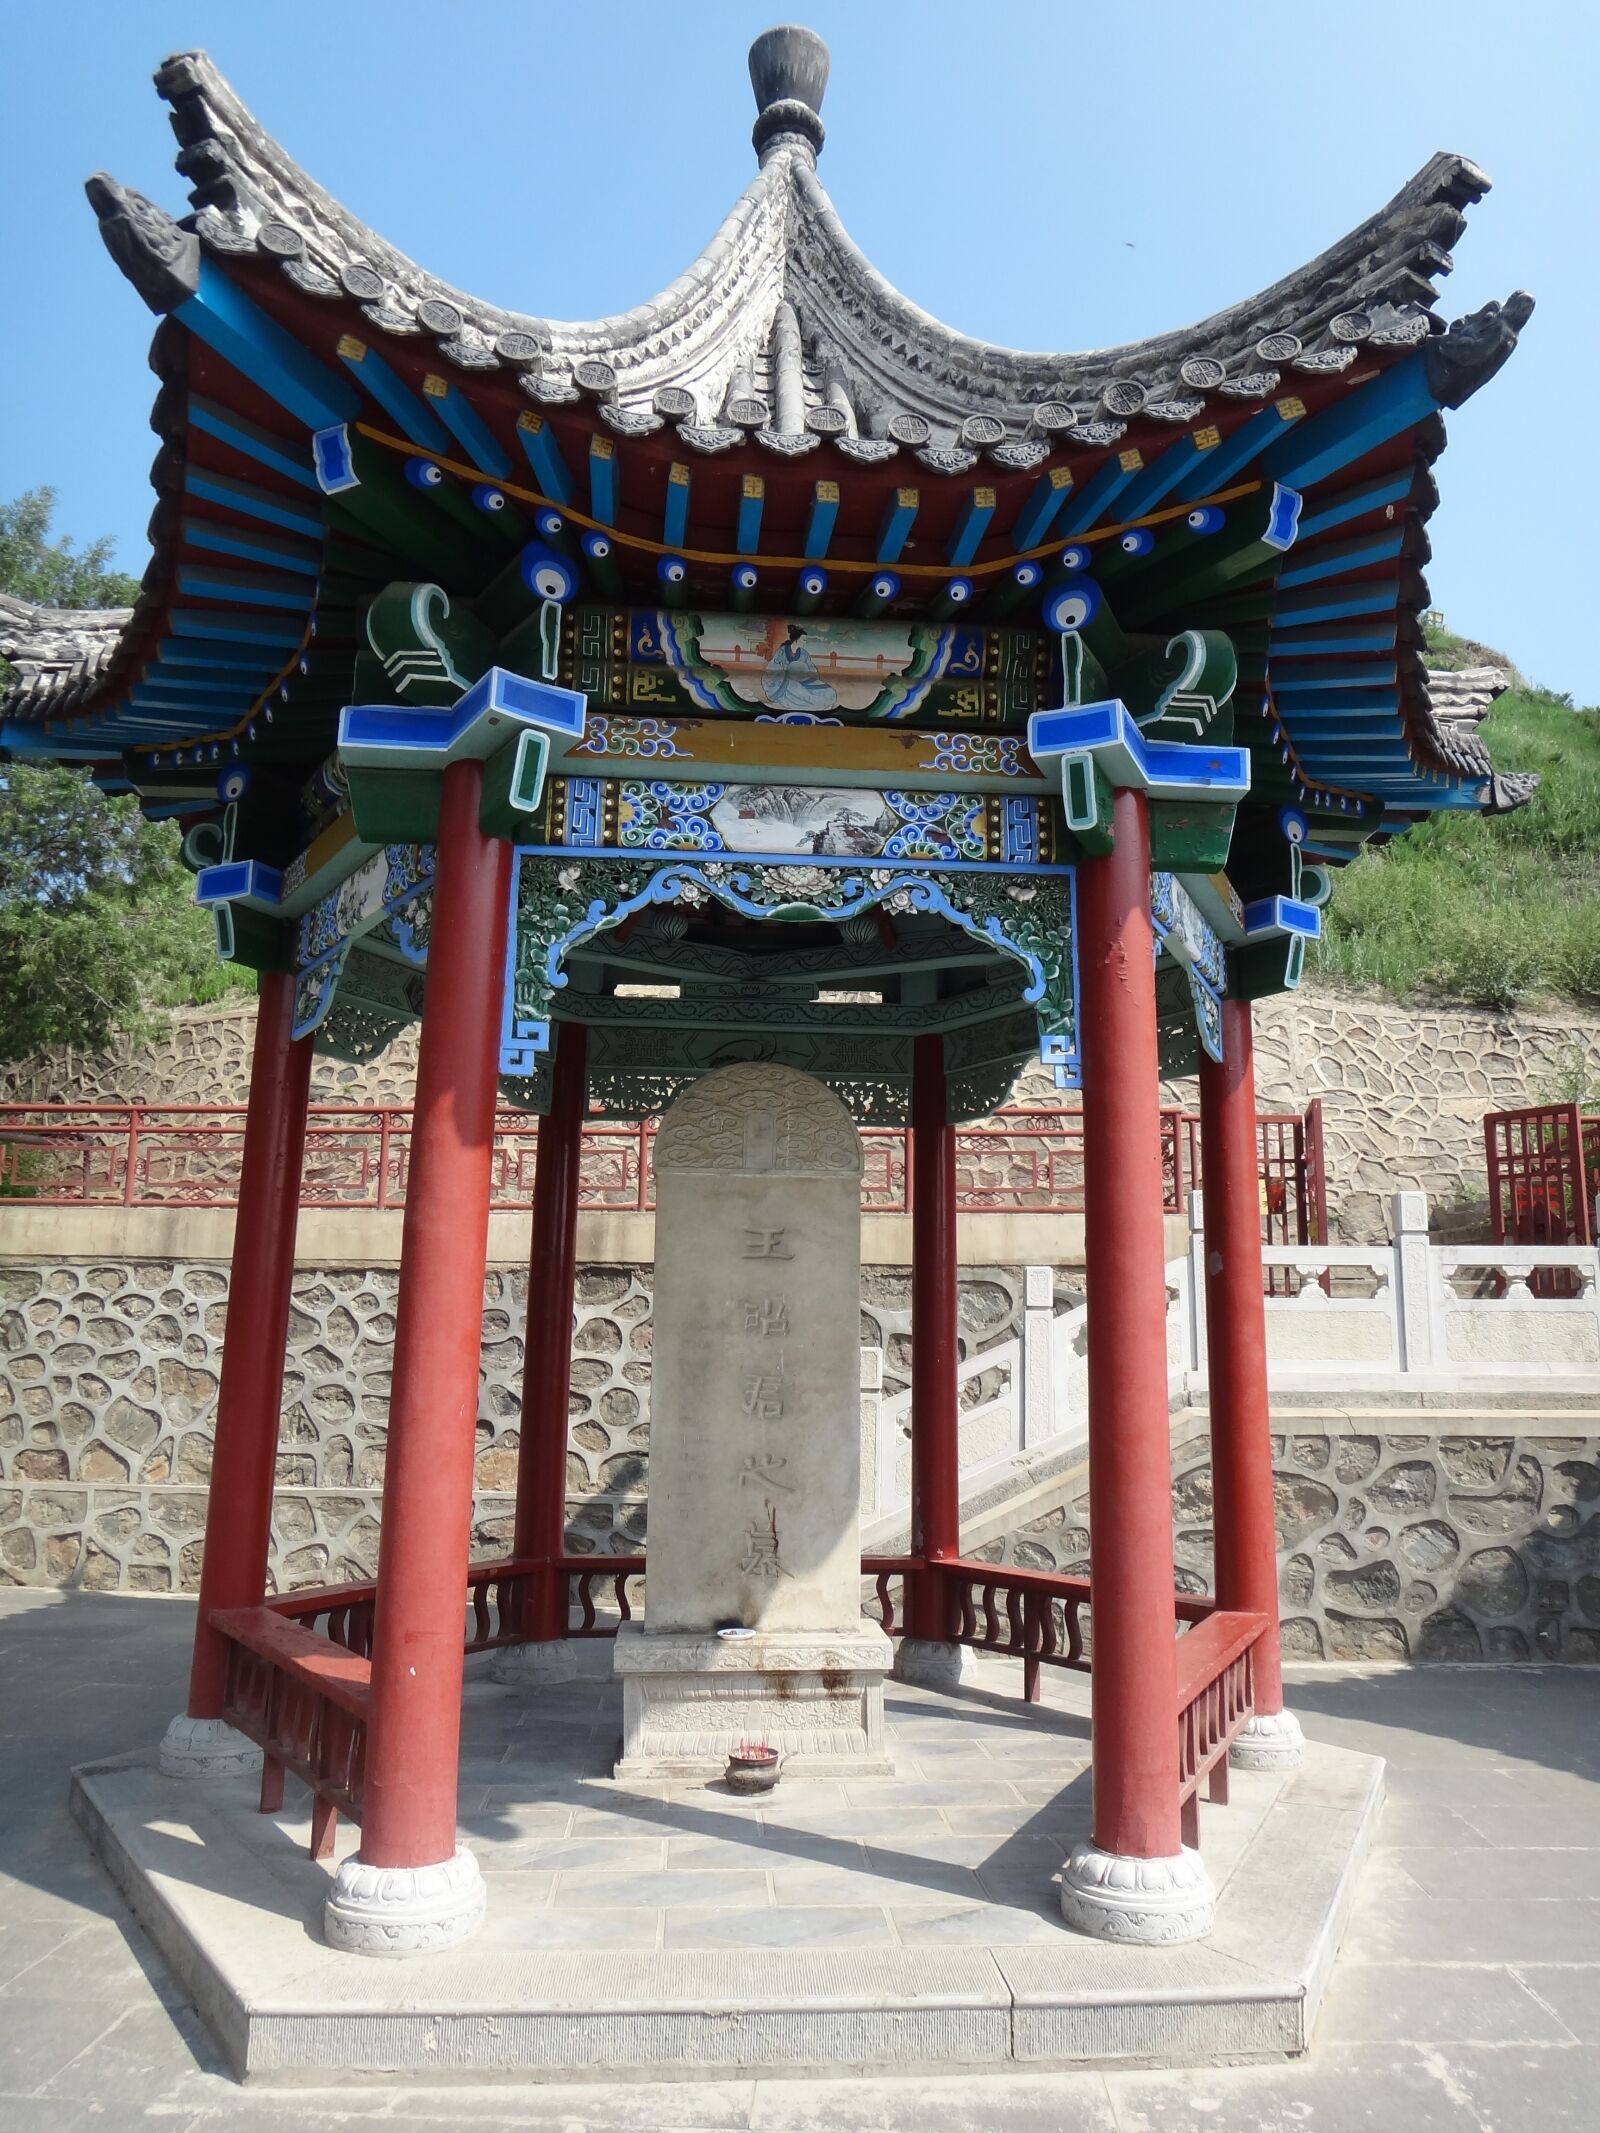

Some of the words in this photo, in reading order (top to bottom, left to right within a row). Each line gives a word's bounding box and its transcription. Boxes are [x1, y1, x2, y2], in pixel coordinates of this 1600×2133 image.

[738, 1227, 796, 1579] 王昭君之墓
